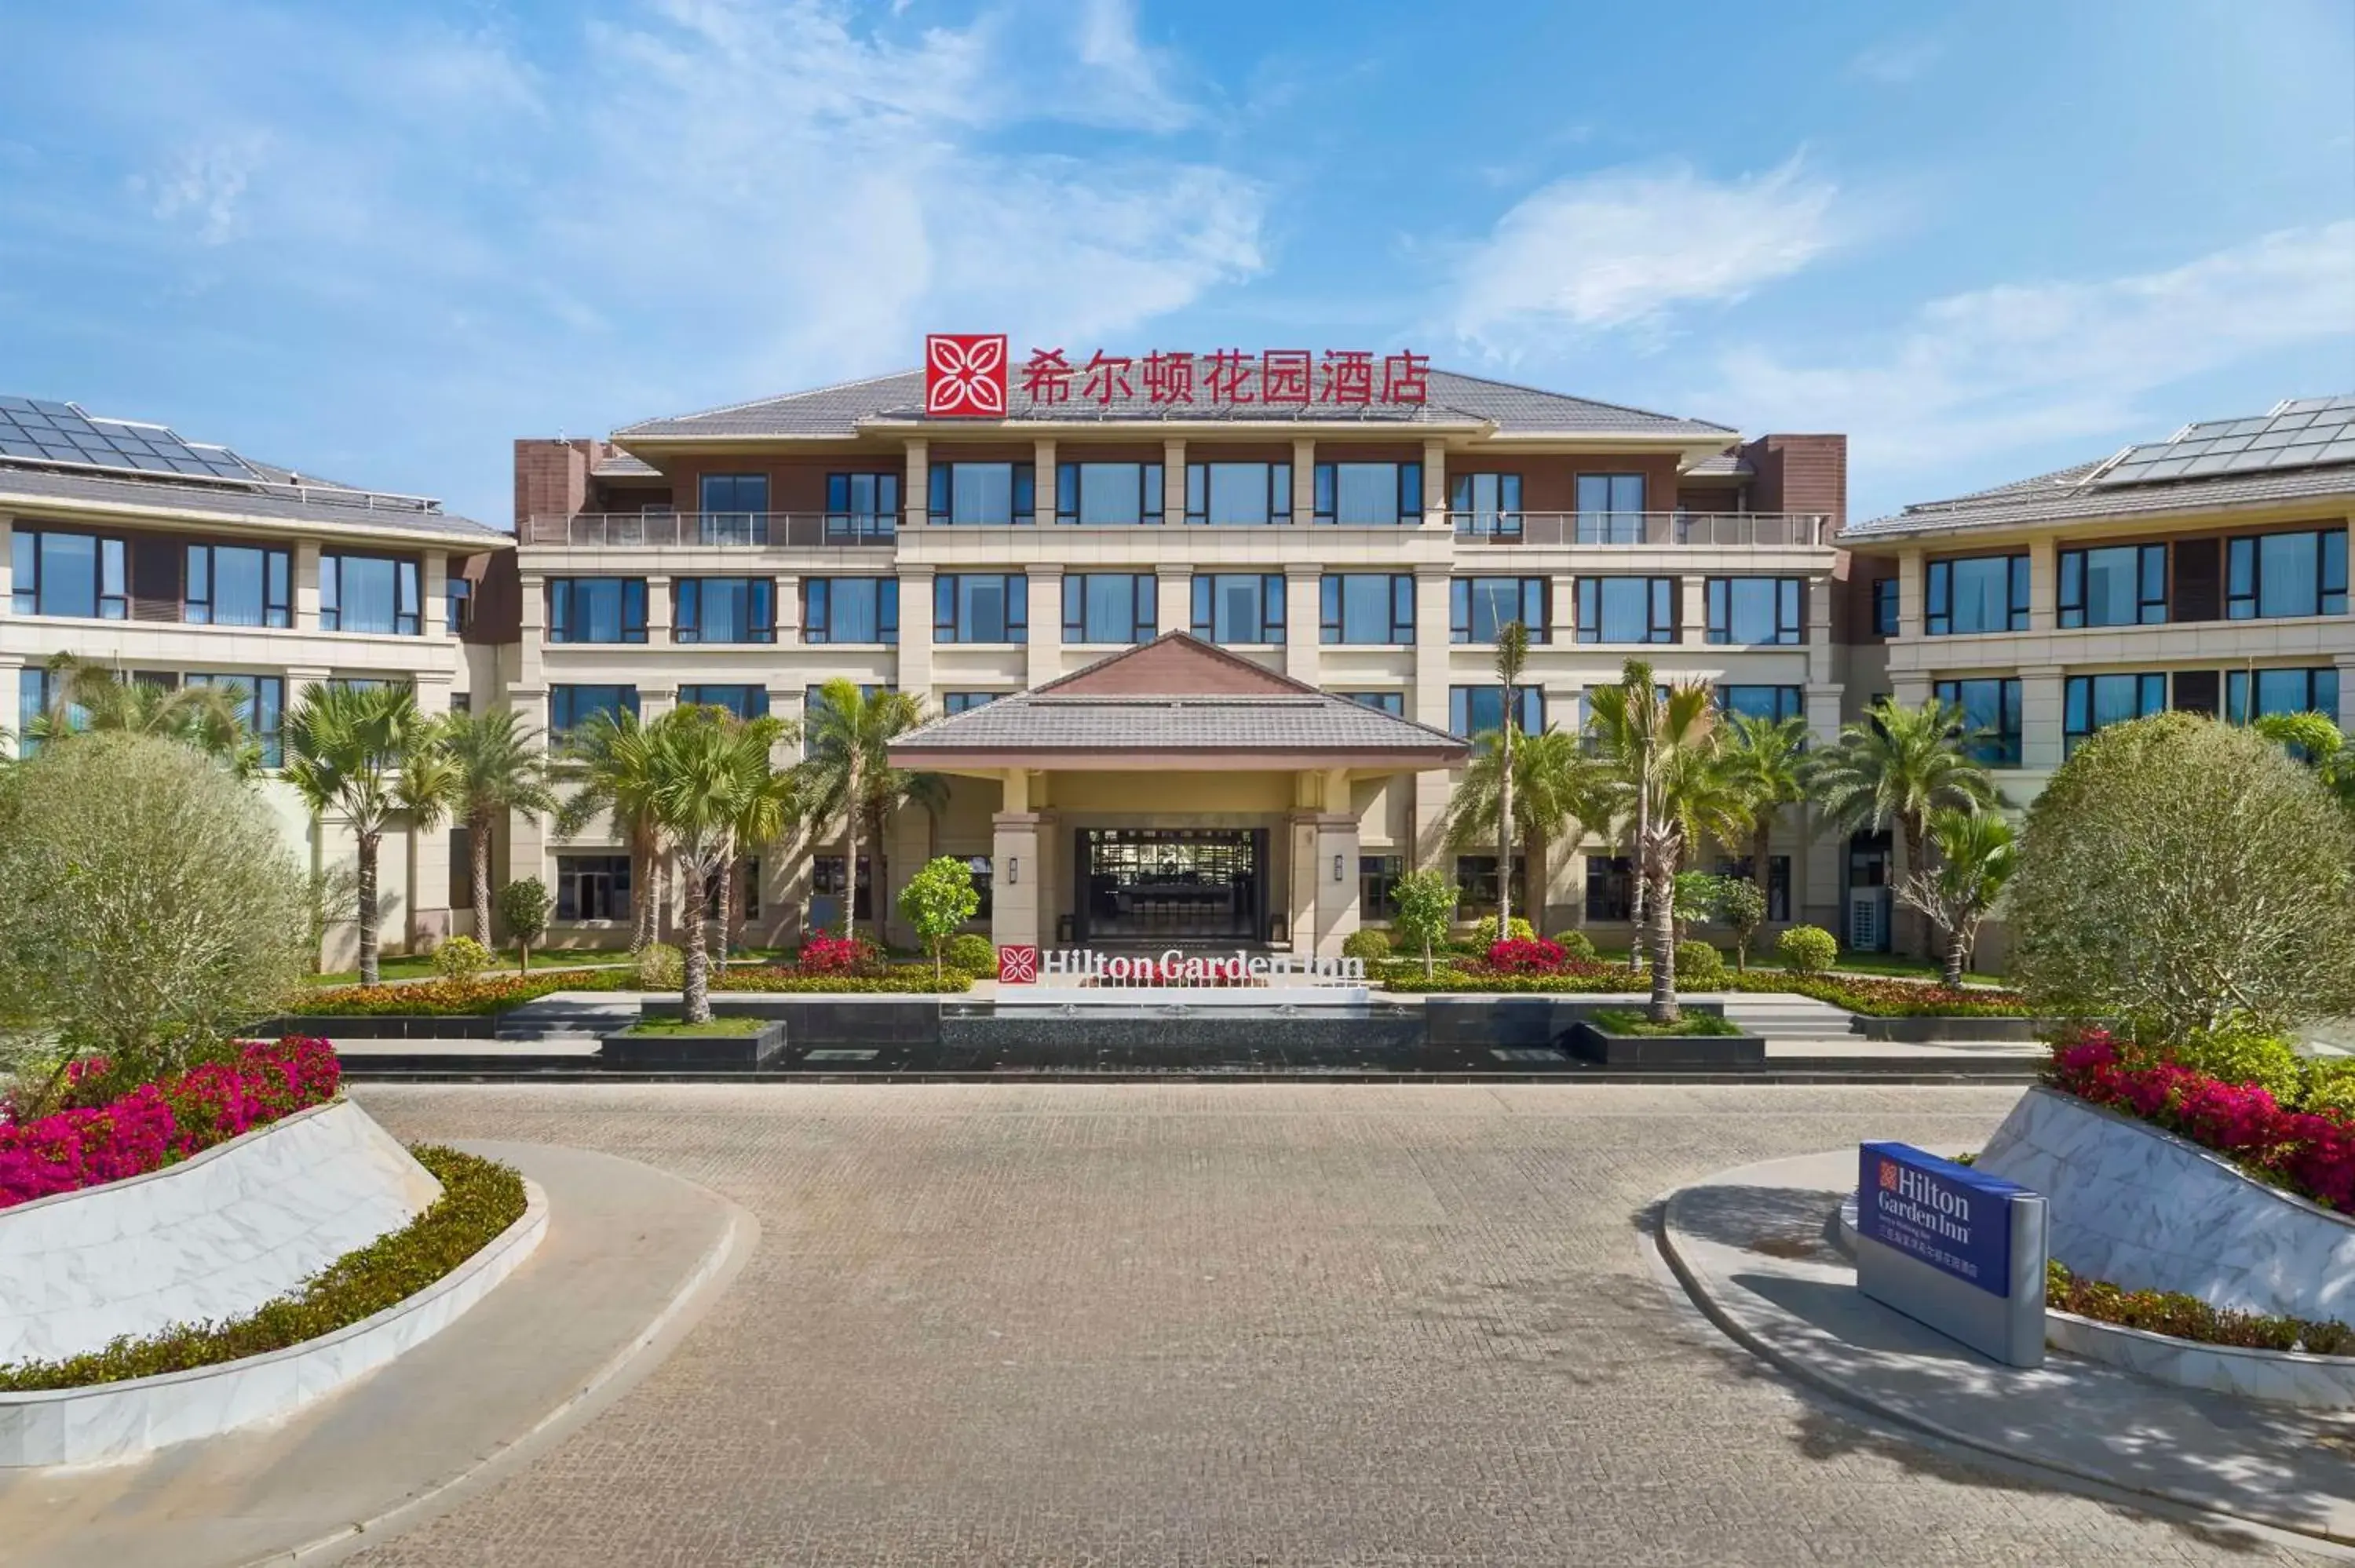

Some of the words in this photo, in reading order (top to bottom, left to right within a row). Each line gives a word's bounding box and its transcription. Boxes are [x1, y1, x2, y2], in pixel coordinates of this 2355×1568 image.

[1021, 348, 1429, 405] 希尔顿花园酒店
[1042, 949, 1153, 979] Hilton
[1160, 949, 1293, 979] Garden
[1305, 952, 1364, 979] Inn
[1879, 1191, 1936, 1231] Garden
[1940, 1215, 1970, 1244] Inn
[1899, 1167, 1970, 1221] Hilton
